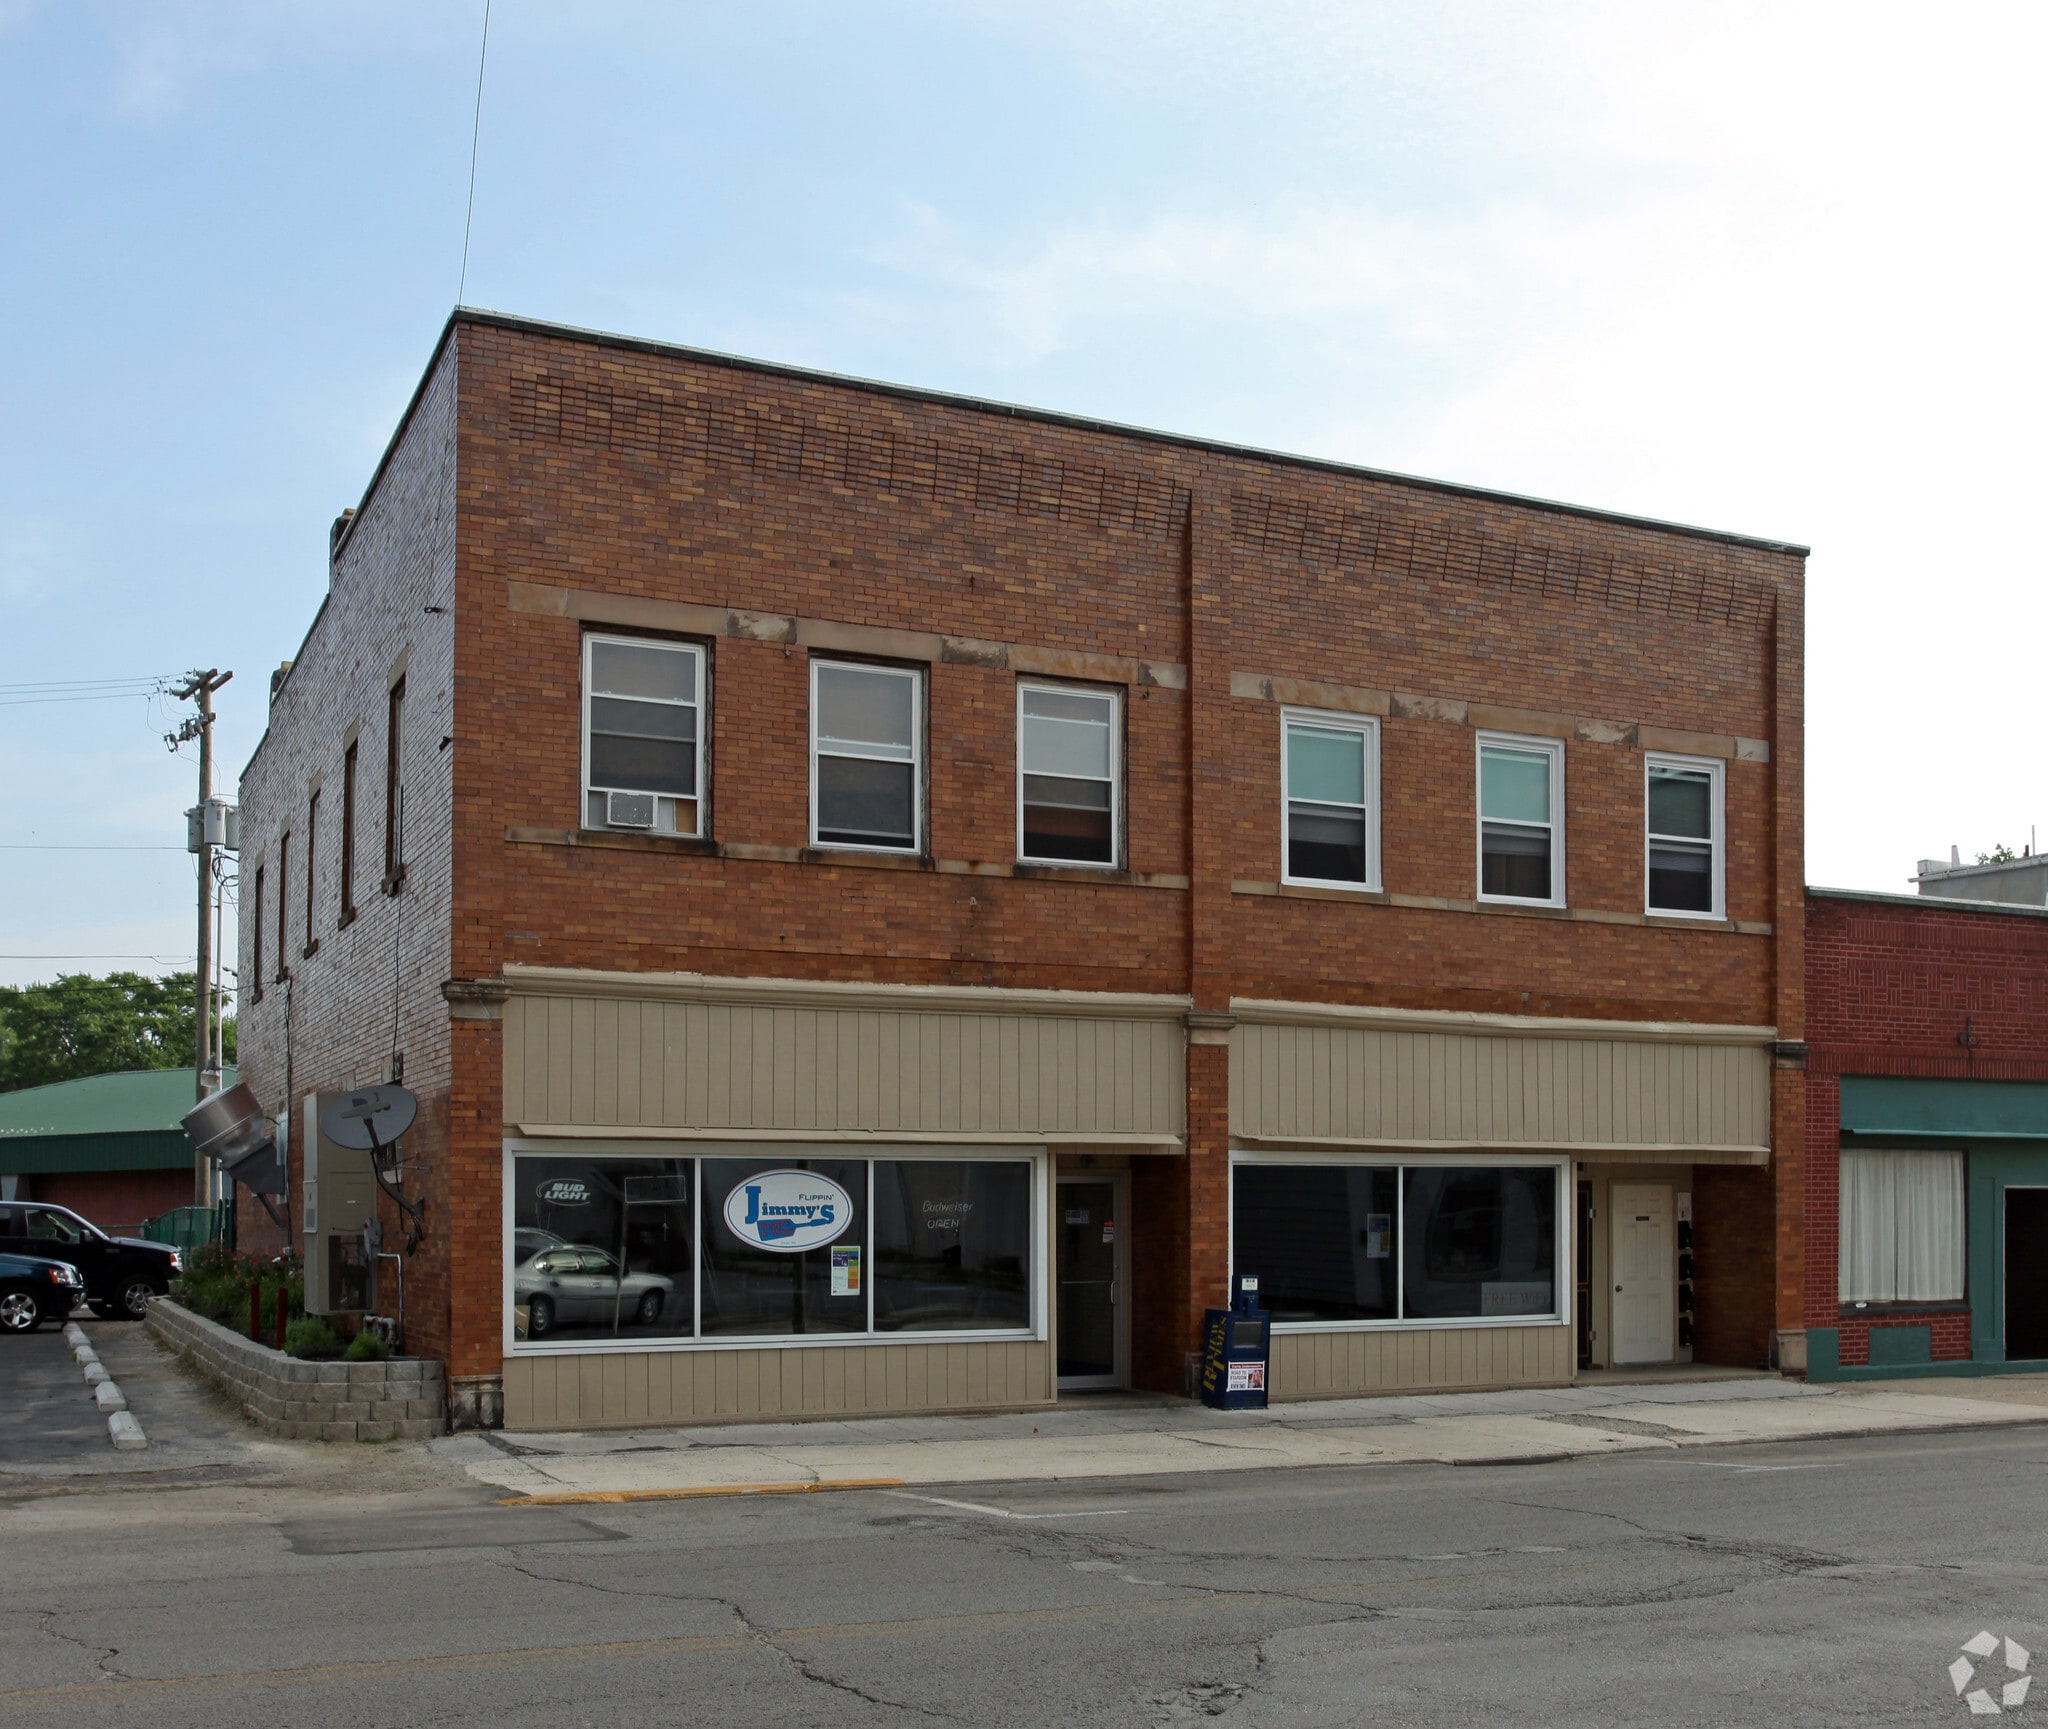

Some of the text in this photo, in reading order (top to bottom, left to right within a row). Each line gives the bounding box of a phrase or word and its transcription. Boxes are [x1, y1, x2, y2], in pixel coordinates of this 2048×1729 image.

[552, 1183, 585, 1192] BUD
[544, 1191, 590, 1200] LIGHT
[922, 1200, 973, 1213] Budweiser
[927, 1219, 960, 1229] OPEN
